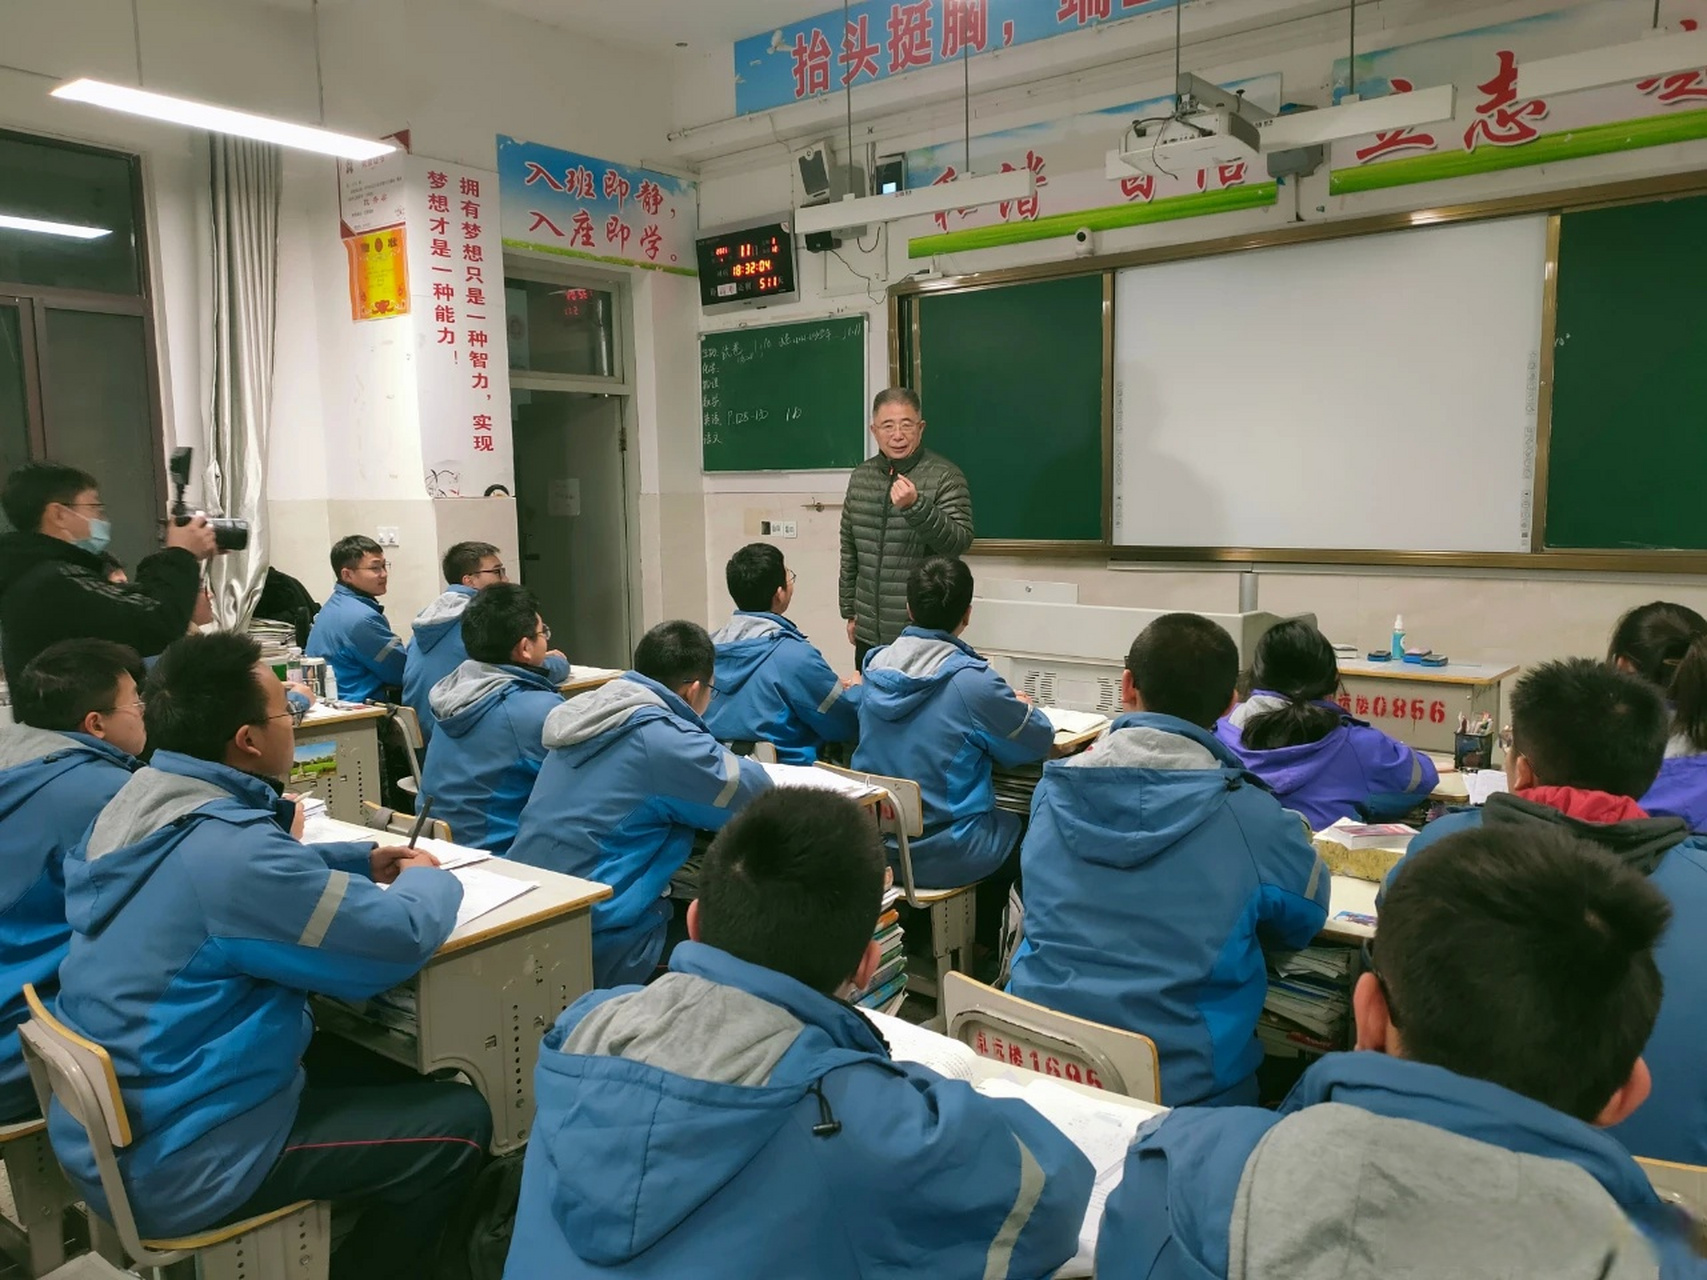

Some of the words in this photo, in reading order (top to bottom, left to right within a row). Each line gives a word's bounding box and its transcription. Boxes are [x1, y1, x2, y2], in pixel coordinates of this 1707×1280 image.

[525, 162, 676, 219] 入班即静，
[528, 209, 678, 261] 入座即学。
[427, 170, 459, 365] 梦想才是一种能力！
[732, 259, 771, 277] 18:32:04
